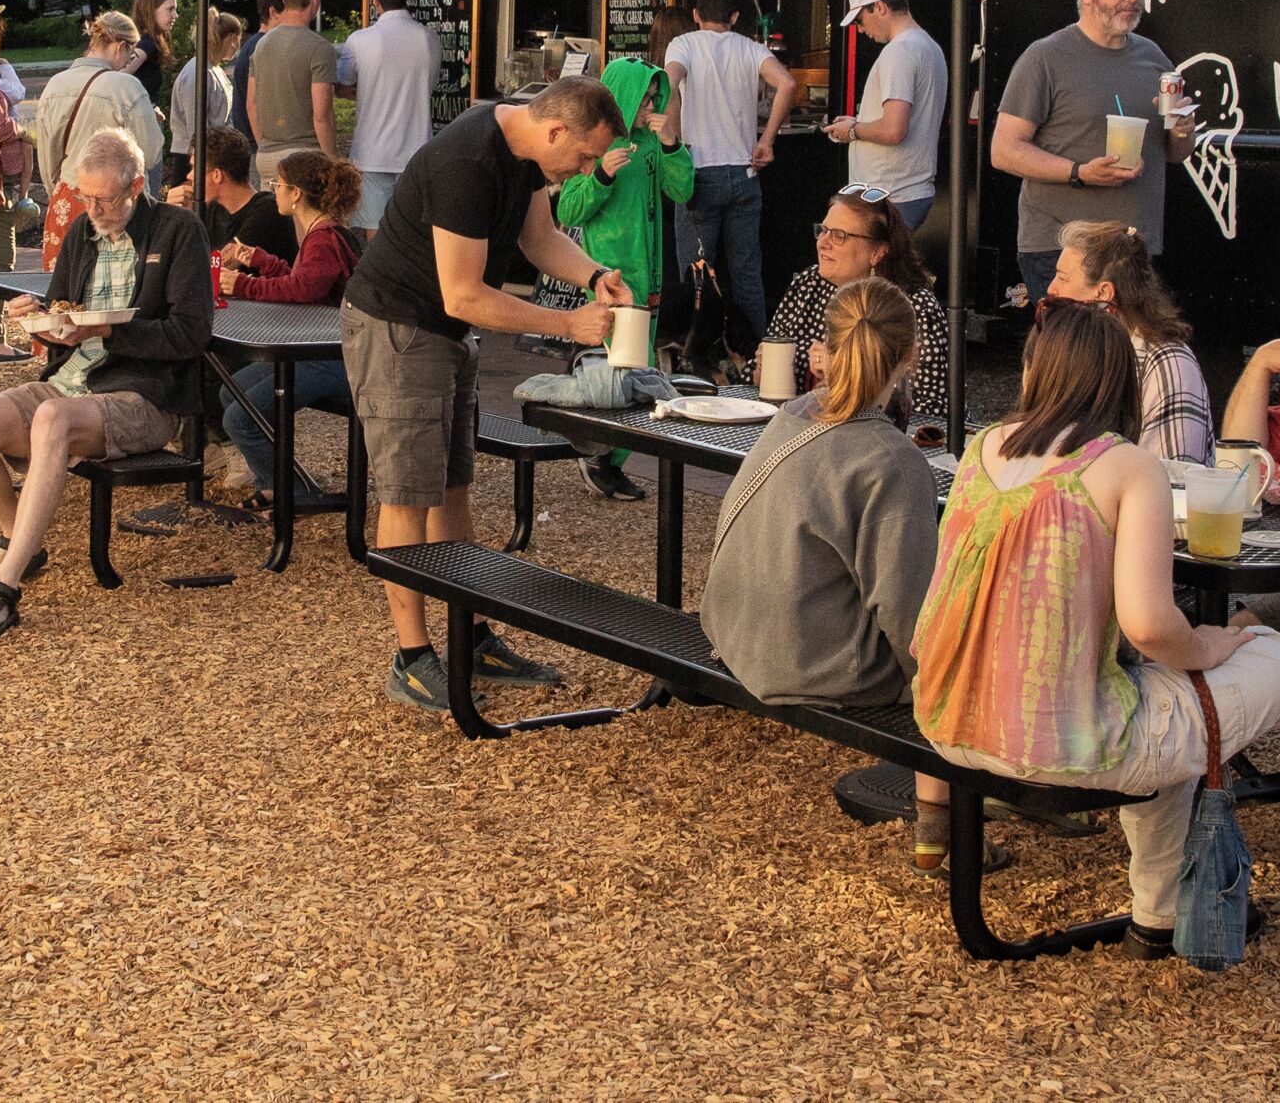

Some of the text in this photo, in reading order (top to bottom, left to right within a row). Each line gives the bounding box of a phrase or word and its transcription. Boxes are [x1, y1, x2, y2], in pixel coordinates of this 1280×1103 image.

[610, 10, 653, 25] STEAK CHEESE SUB
[211, 256, 220, 268] 35
[538, 289, 589, 311] SQUEEZE
